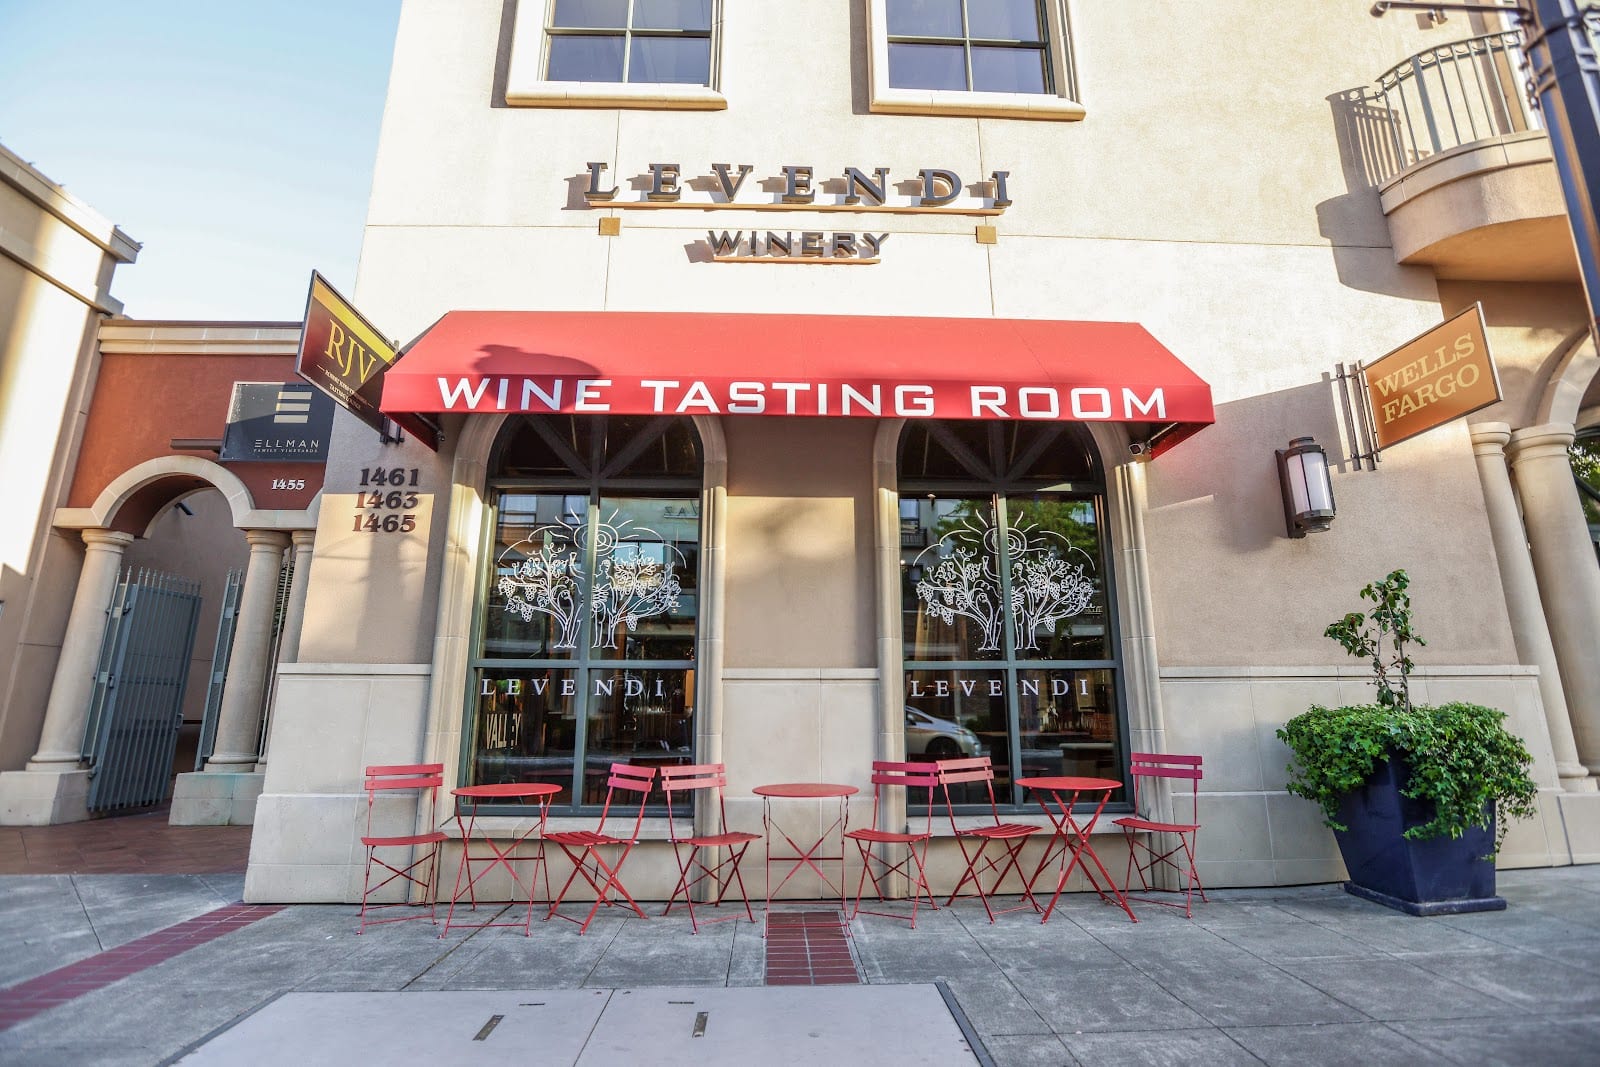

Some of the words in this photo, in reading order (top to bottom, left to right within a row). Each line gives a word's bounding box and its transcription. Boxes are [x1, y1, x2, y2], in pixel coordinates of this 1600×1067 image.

[584, 161, 1012, 209] LEVENDI
[707, 230, 890, 256] WINERY
[324, 319, 377, 384] RJV
[1374, 332, 1475, 398] WELLS
[438, 377, 612, 411] WINE
[640, 379, 935, 417] TASTING
[970, 385, 1167, 419] ROOM
[1381, 363, 1480, 425] FARGO
[254, 439, 319, 448] ELLMAN
[271, 478, 305, 491] 1455
[359, 466, 419, 487] 1461
[354, 488, 419, 510] 1463
[352, 512, 416, 533] 1465
[481, 678, 664, 696] LEVENDI
[910, 679, 1089, 697] LEVENDI
